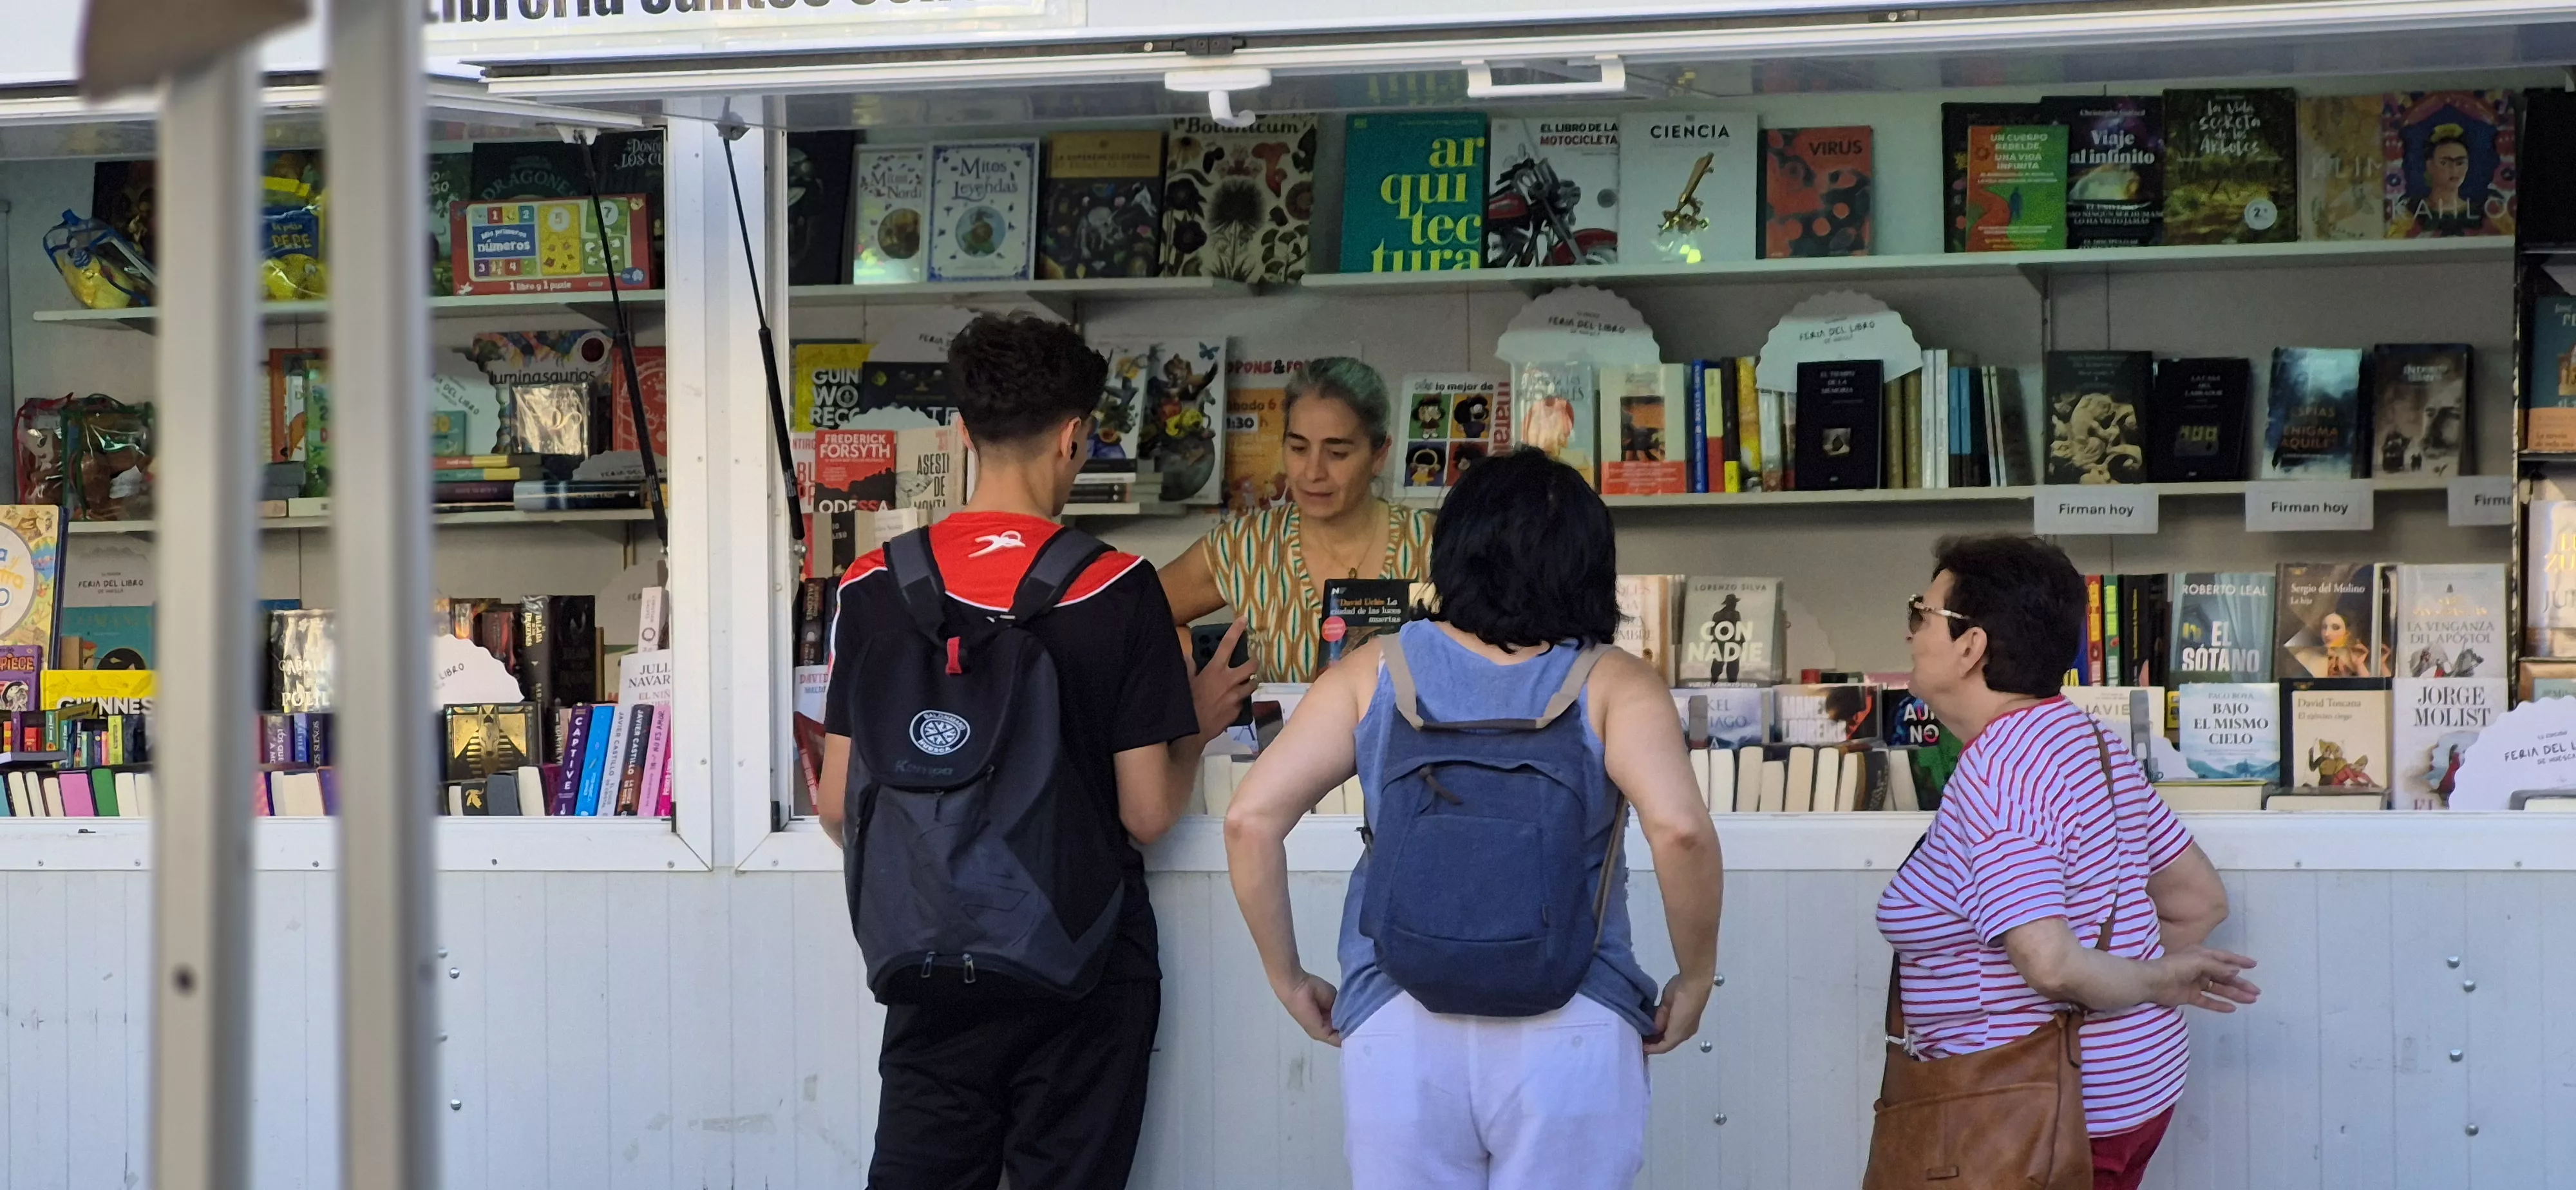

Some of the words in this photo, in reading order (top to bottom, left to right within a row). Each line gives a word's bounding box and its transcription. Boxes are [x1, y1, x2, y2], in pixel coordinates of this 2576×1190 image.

[1540, 124, 1553, 133] EL
[1555, 124, 1587, 133] LIBRO
[1589, 123, 1602, 132] DE
[1604, 123, 1618, 131] LA
[1651, 124, 1730, 139] CIENCIA
[1540, 134, 1618, 146] MOTOCICLETA
[2007, 133, 2048, 142] CUERPO
[2091, 129, 2136, 150] Viaje
[1429, 137, 1486, 168] ar
[1808, 140, 1863, 156] VIRUS
[2020, 153, 2042, 161] VIDA
[2069, 148, 2087, 164] al
[2088, 148, 2155, 165] infinito
[960, 157, 1007, 179] Mitos
[870, 171, 909, 187] Mitos
[952, 178, 1018, 202] Leyendas
[1380, 172, 1468, 220] qui
[602, 205, 612, 218] 7
[2392, 197, 2508, 221] KAHLO
[554, 211, 563, 225] 5
[1412, 203, 1482, 245] tec
[271, 233, 313, 249] PEPE
[477, 239, 531, 253] números
[1371, 238, 1480, 273] tura
[478, 263, 486, 273] 3
[509, 261, 516, 272] 4
[1598, 321, 1625, 334] LIBRO
[1799, 329, 1824, 341] FERIA
[1829, 326, 1846, 336] DEL
[1849, 321, 1875, 332] LIBRO
[489, 368, 596, 386] luminasaurios
[811, 368, 861, 385] GUIN
[1446, 381, 1479, 393] mejor
[1481, 381, 1494, 391] de
[1268, 397, 1276, 410] 6
[824, 433, 886, 444] FREDERICK
[820, 443, 891, 458] FORSYTH
[934, 475, 945, 497] DE
[819, 499, 889, 514] ODESSA
[2059, 503, 2107, 515] Firman
[2109, 504, 2135, 517] hoy
[2271, 500, 2320, 514] Firman
[2323, 502, 2349, 516] hoy
[77, 580, 100, 589] FERIA
[103, 580, 118, 588] DEL
[120, 579, 144, 587] LIBRO
[1694, 583, 1738, 592] LORENZO
[1740, 583, 1767, 592] SILVA
[2181, 583, 2236, 596] ROBERTO
[2239, 584, 2268, 596] LEAL
[2290, 583, 2317, 596] Sergio
[2318, 582, 2331, 594] del
[2333, 583, 2366, 594] Molino
[1387, 597, 1398, 606] La
[2290, 596, 2299, 605] La
[2300, 596, 2313, 606] hija
[1330, 607, 1356, 615] ciudad
[1368, 607, 1380, 615] las
[1381, 607, 1402, 615] luces
[1700, 620, 1753, 642] CON
[2407, 621, 2424, 632] LA
[2429, 620, 2496, 632] VENGANZA
[2211, 621, 2232, 647] EL
[1687, 641, 1763, 663] NADIE
[2181, 643, 2260, 673] SÓTANO
[439, 662, 465, 681] LIBRO
[800, 673, 829, 685] DAVID
[629, 674, 670, 688] NAVAR
[639, 692, 652, 701] EL
[2297, 697, 2324, 708] David
[2325, 697, 2362, 708] Toscana
[2417, 685, 2486, 707] JORGE
[2212, 703, 2249, 716] BAJO
[2413, 706, 2491, 728] MOLIST
[614, 711, 625, 738] JAVIER
[635, 709, 644, 737] JAVIER
[2193, 717, 2211, 730] EL
[2213, 717, 2269, 730] MISMO
[1909, 724, 1940, 743] NO
[2208, 732, 2253, 745] CIELO
[564, 716, 583, 791] CAPTIVE
[608, 739, 620, 777] CASTILLO
[627, 737, 639, 776] CASTILLO
[2504, 747, 2539, 763] FERIA
[2543, 742, 2566, 755] DEL
